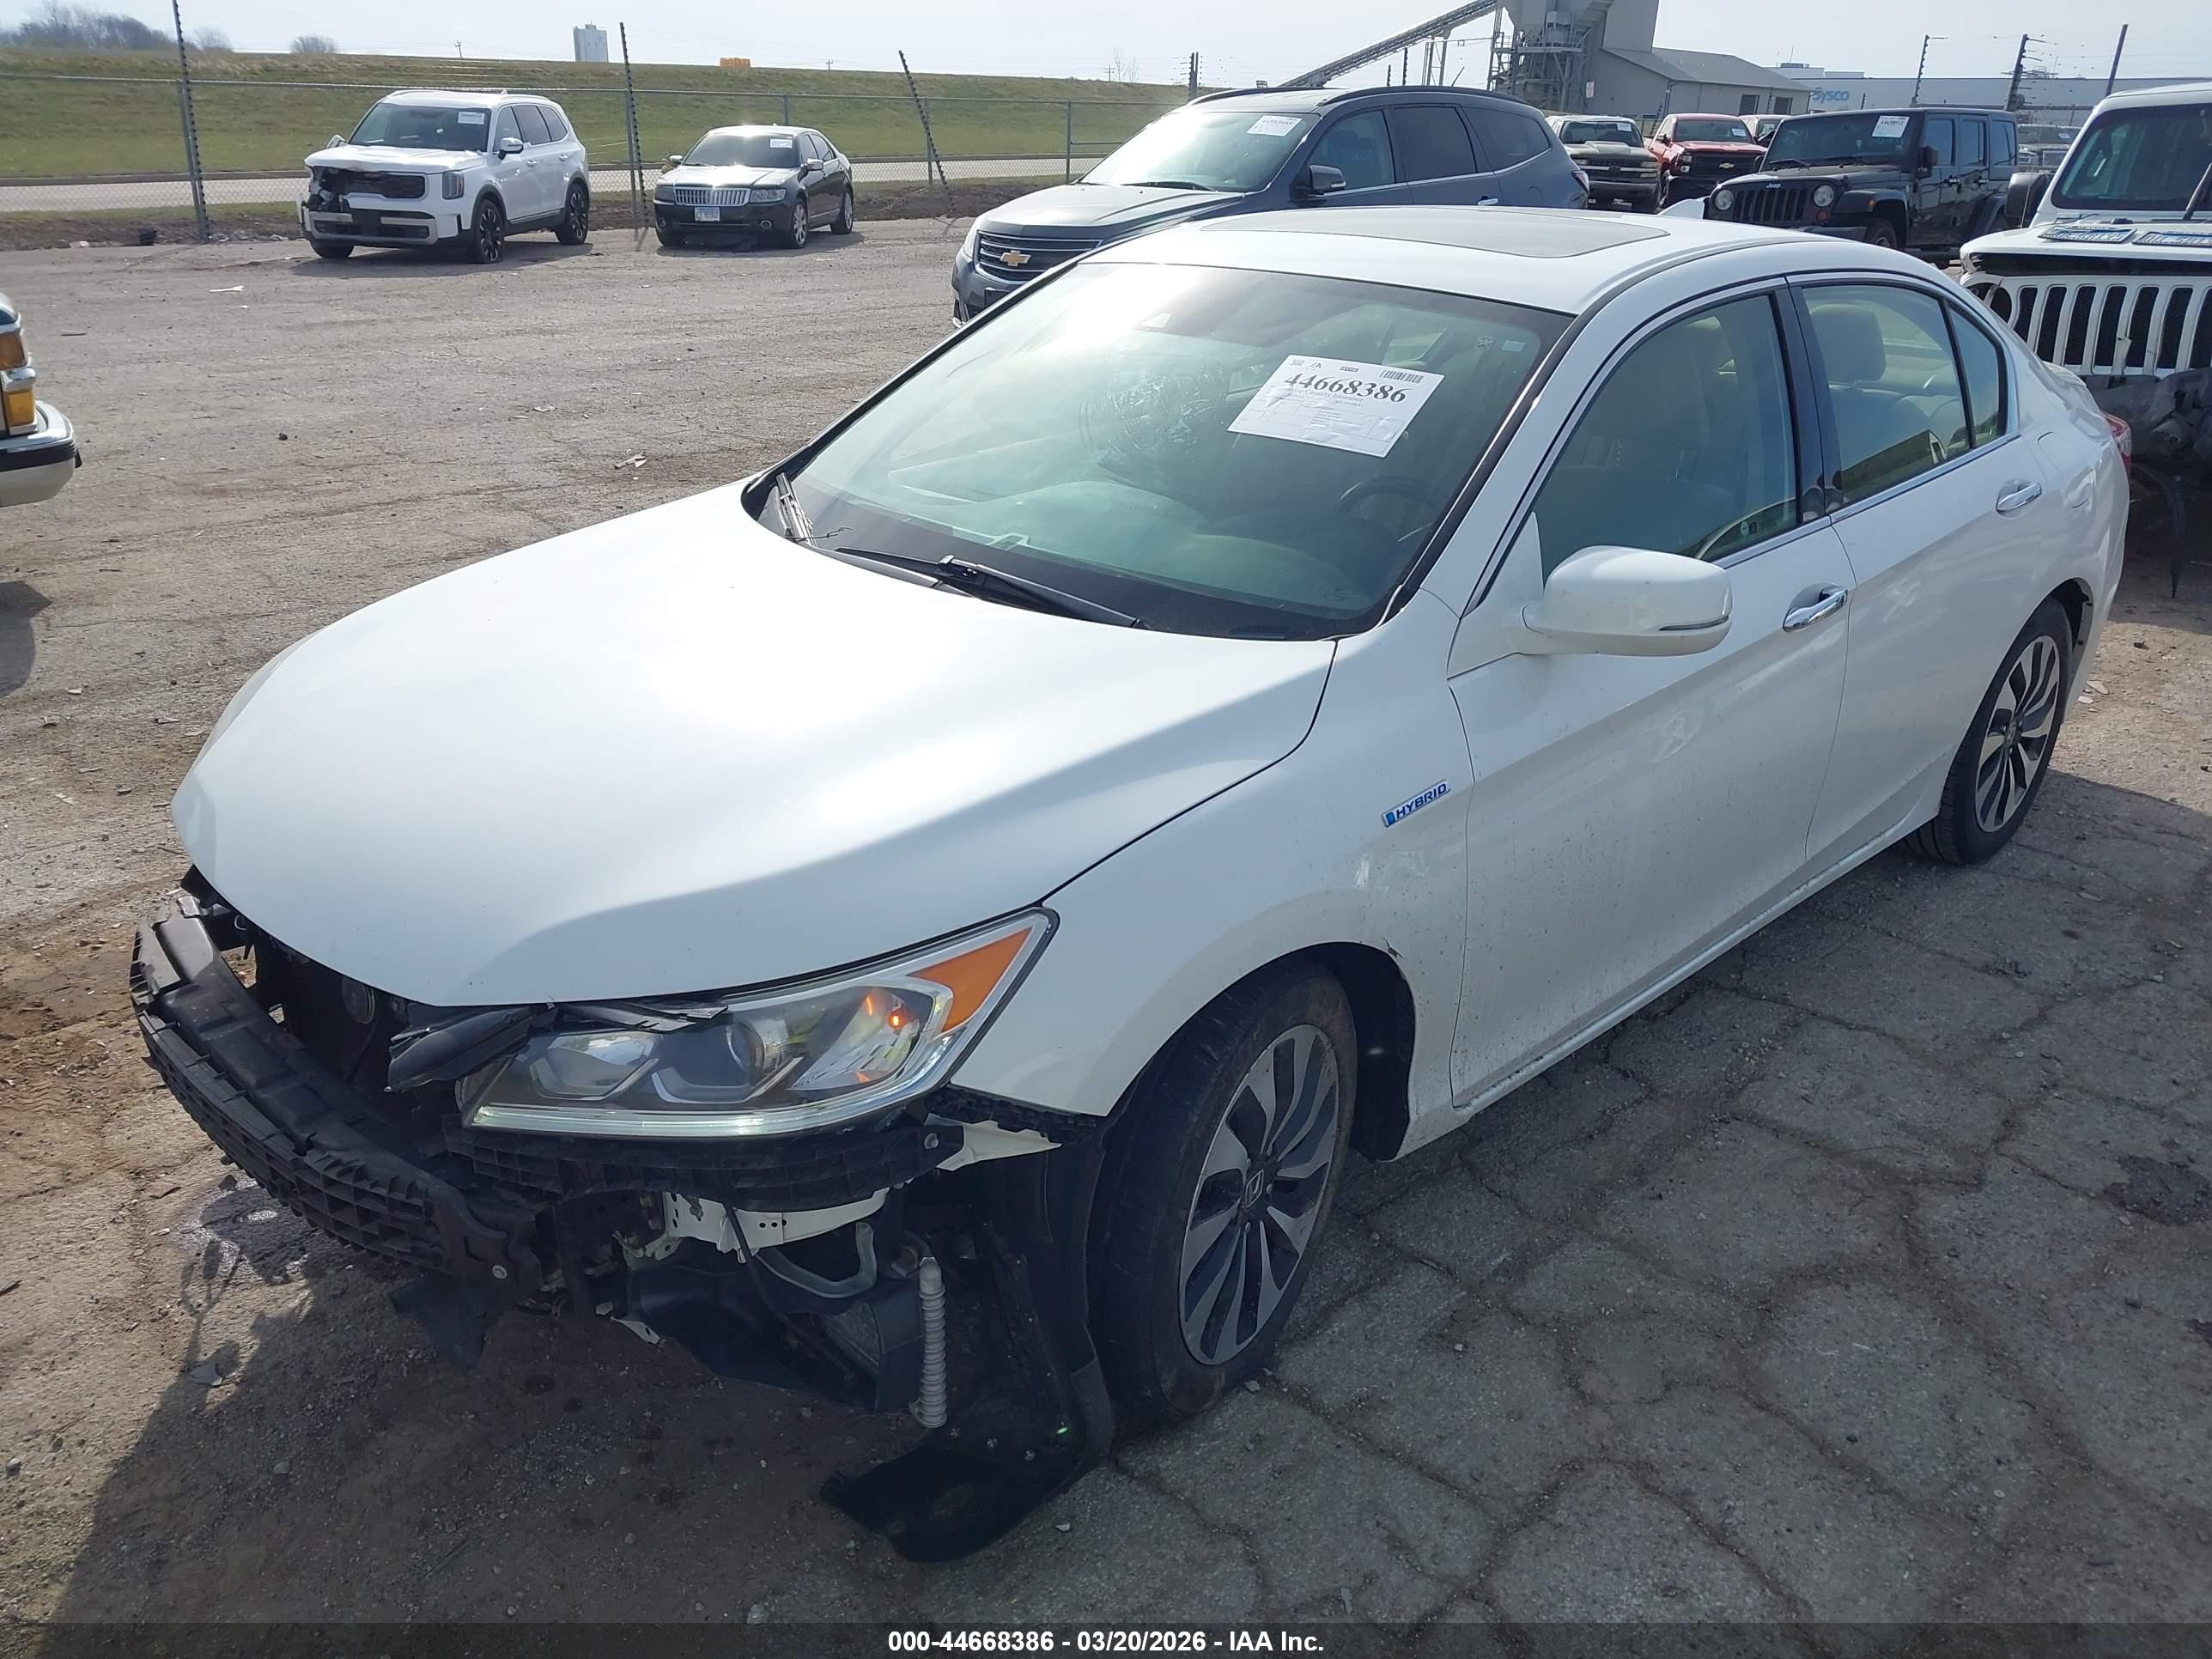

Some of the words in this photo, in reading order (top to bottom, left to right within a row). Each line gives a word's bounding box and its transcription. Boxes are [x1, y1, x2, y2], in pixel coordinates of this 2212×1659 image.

[1765, 181, 1782, 190] Jeep
[1284, 373, 1413, 403] 44668386
[1395, 783, 1447, 819] HYBRID
